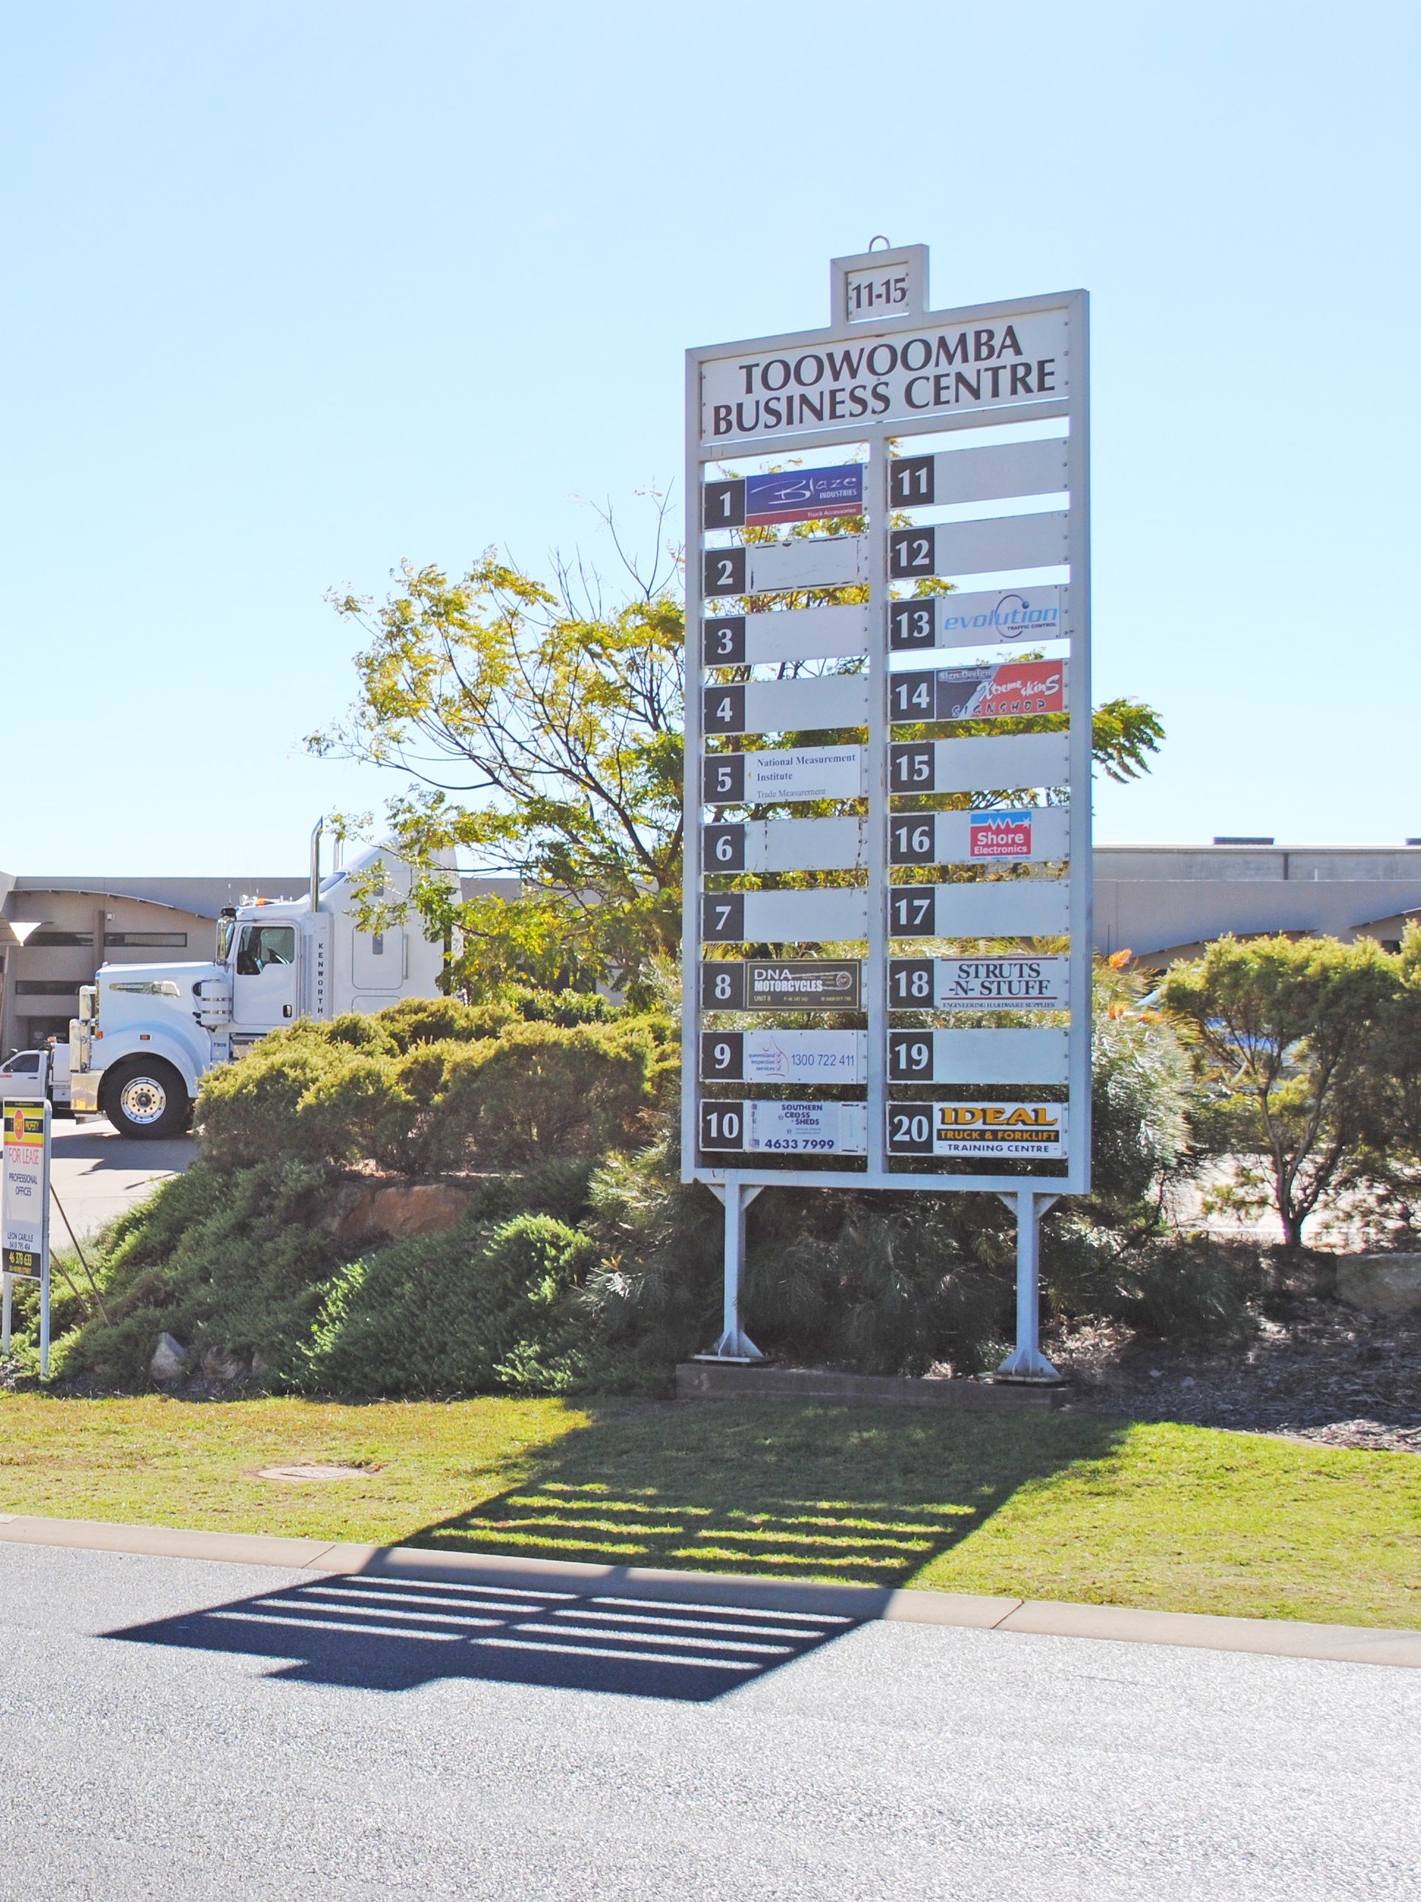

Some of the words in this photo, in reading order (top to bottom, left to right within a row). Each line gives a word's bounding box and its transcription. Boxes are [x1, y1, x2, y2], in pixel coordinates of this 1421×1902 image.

[851, 278, 907, 309] 11-15
[738, 325, 1022, 395] TOOWOOMBA
[713, 382, 891, 436] BUSINESS
[904, 359, 1056, 409] CENTRE
[750, 478, 857, 505] Blaze
[898, 466, 928, 496] 11
[720, 491, 731, 517] 1
[820, 489, 857, 499] INDUSTRIES
[824, 508, 856, 516] Accessories
[895, 539, 930, 567] 12
[717, 560, 734, 586] 2
[896, 611, 930, 639] 13
[944, 607, 1058, 630] evolution
[717, 628, 733, 654] 3
[895, 683, 930, 710] 14
[716, 697, 733, 722] 4
[757, 757, 793, 767] National
[796, 754, 856, 765] Measurement
[895, 754, 930, 782] 15
[717, 767, 732, 792] 5
[757, 772, 793, 782] Institute
[757, 790, 776, 798] Trade
[778, 788, 826, 797] Measurement
[716, 836, 733, 861] 6
[895, 826, 930, 853] 16
[974, 845, 1028, 854] Electronics
[977, 832, 1024, 845] Shore
[715, 906, 732, 931] 7
[895, 899, 931, 925] 17
[754, 969, 792, 980] DNA
[958, 963, 1041, 979] STRUTS
[715, 974, 732, 999] 8
[754, 980, 823, 992] MOTORCYCLES
[894, 971, 930, 997] 18
[949, 981, 975, 995] -N-
[980, 980, 1050, 995] STUFF
[714, 1043, 730, 1069] 9
[791, 1054, 814, 1066] 1300
[817, 1054, 836, 1066] 722
[839, 1054, 854, 1066] 411
[894, 1044, 929, 1070] 19
[706, 1112, 739, 1139] 10
[893, 1115, 929, 1142] 20
[939, 1107, 1058, 1126] IDEAL
[765, 1139, 798, 1149] 4633
[802, 1139, 835, 1149] 7999
[940, 1130, 980, 1139] TRUCK
[985, 1131, 993, 1140] &
[997, 1131, 1056, 1140] FORKLIFT
[8, 1147, 21, 1163] FOR
[22, 1148, 39, 1165] LEASE
[948, 1144, 1003, 1152] TRAINING
[1007, 1144, 1050, 1152] CENTRE
[9, 1172, 37, 1184] PROFESSIONAL
